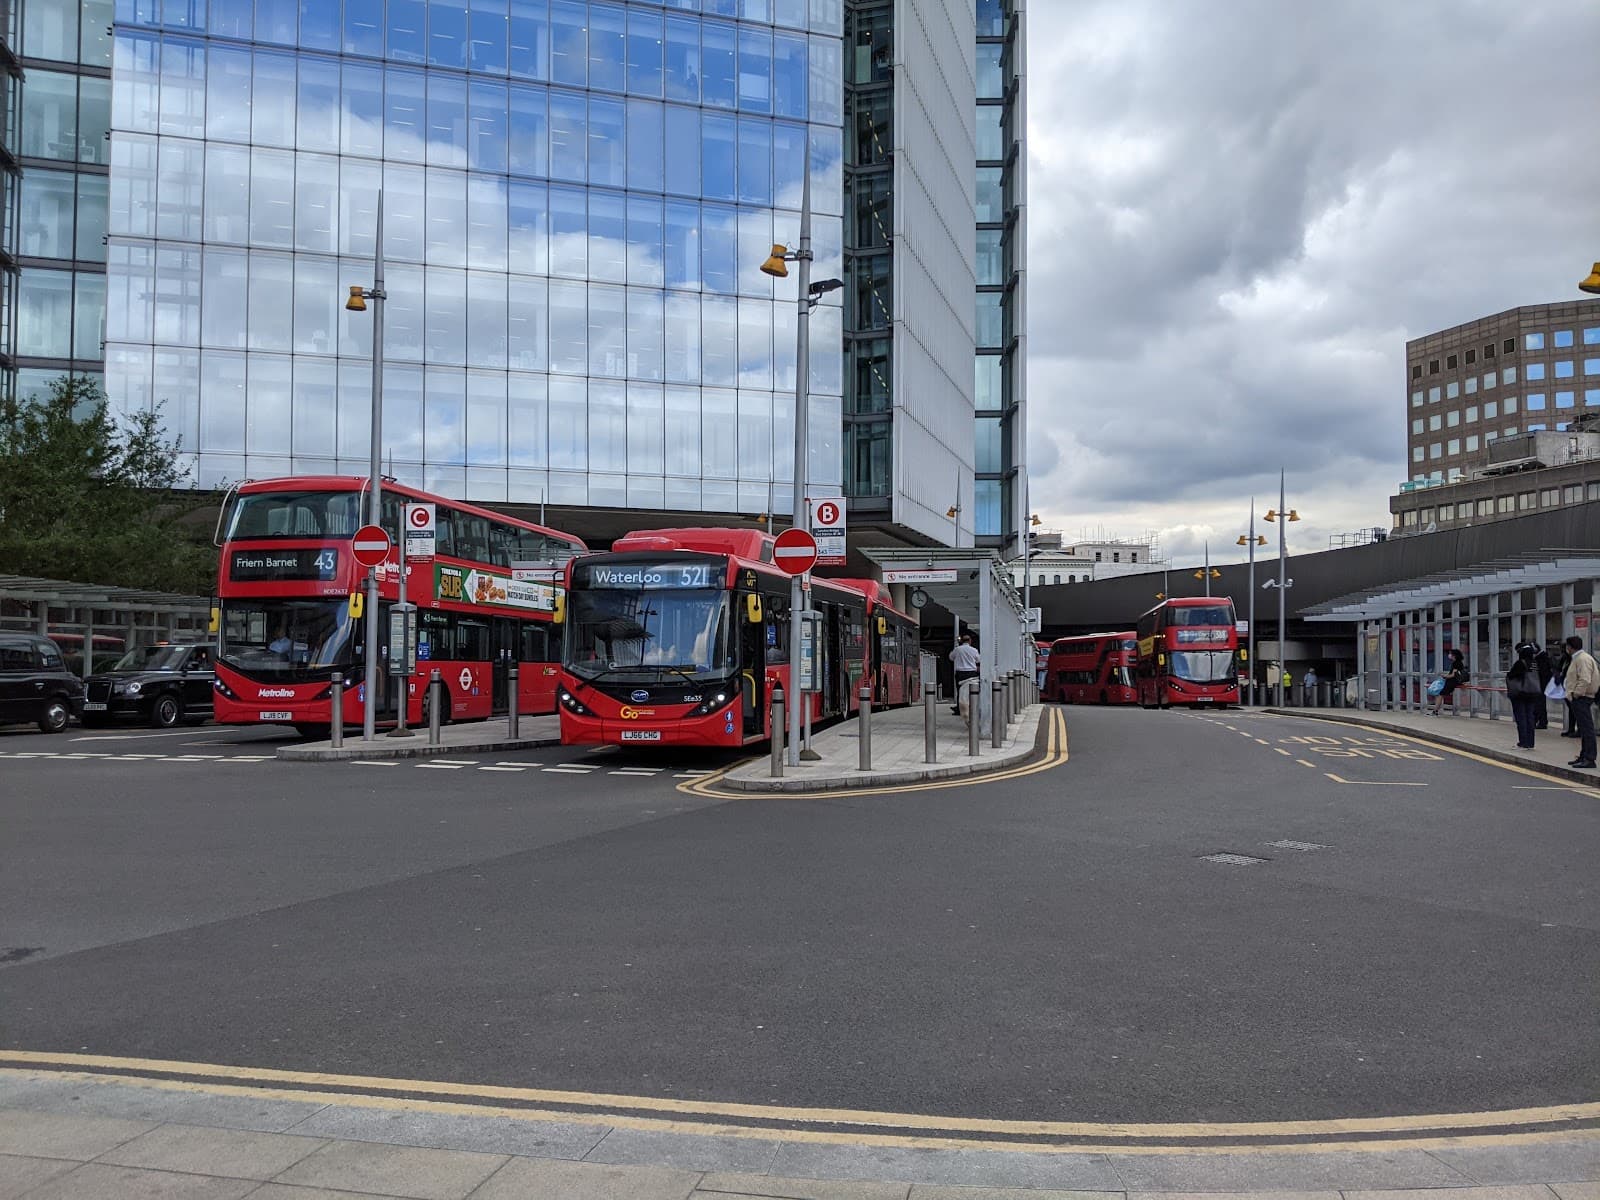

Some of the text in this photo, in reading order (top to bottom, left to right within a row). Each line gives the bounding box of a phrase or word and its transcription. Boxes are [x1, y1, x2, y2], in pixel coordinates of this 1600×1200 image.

[413, 510, 426, 525] C
[822, 505, 834, 522] B
[236, 557, 298, 568] Friern Barnet
[313, 552, 335, 570] 43
[595, 569, 662, 584] Waterloo
[680, 566, 707, 586] 521
[440, 574, 462, 598] SUB
[258, 688, 295, 698] Metroline
[620, 705, 639, 719] Go
[624, 731, 642, 739] LJ66
[1309, 746, 1446, 761] BUS
